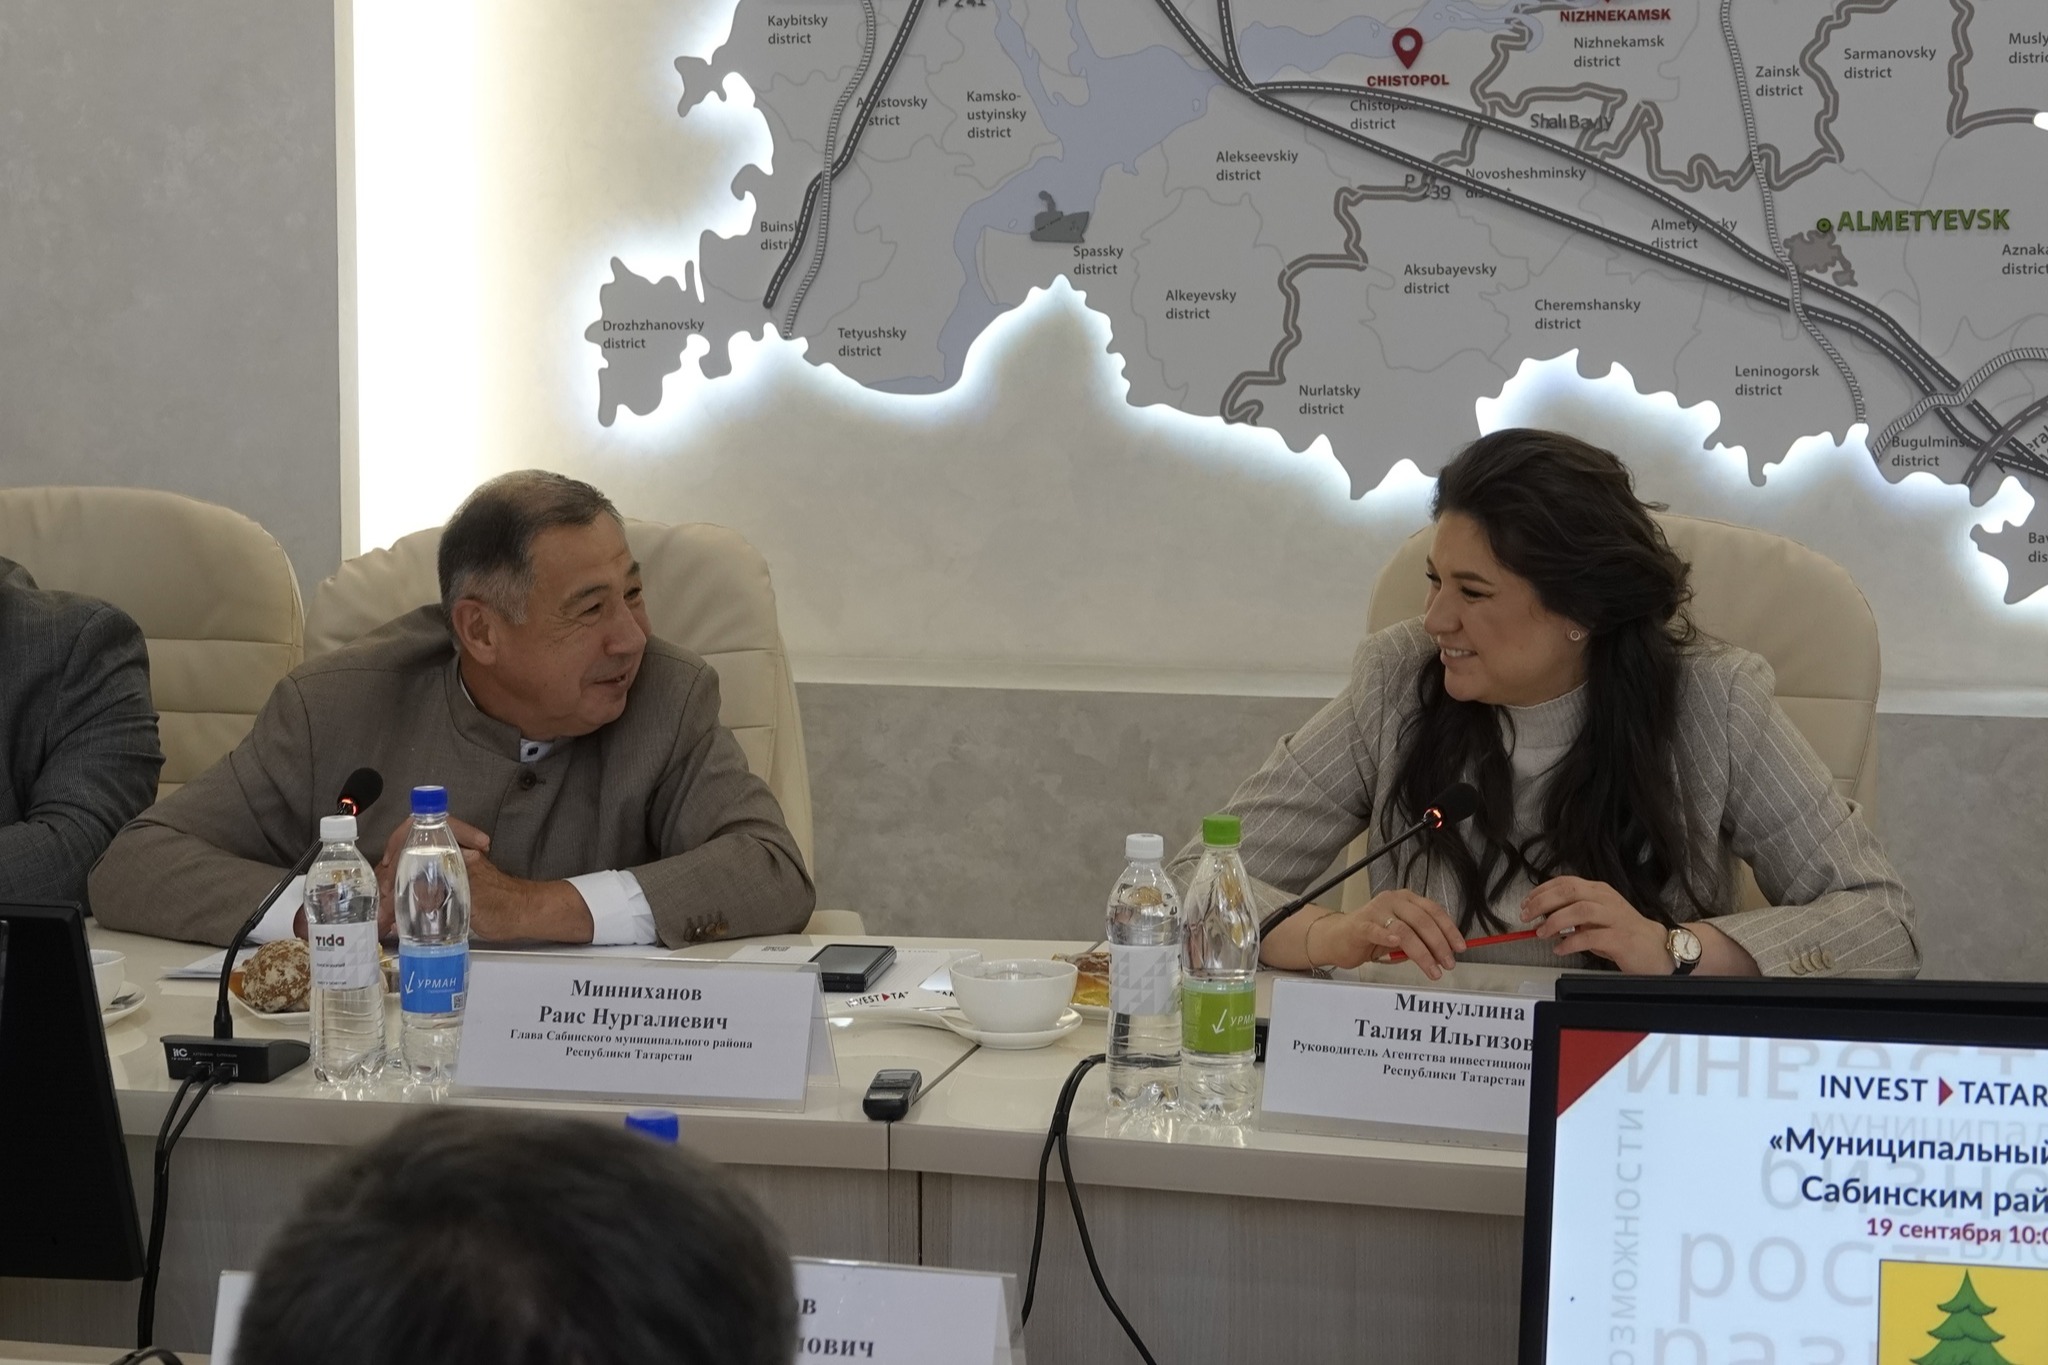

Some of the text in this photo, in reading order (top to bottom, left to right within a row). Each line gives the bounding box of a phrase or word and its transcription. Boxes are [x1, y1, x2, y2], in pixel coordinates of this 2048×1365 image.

[767, 14, 828, 28] Kaybitsky
[1560, 8, 1671, 22] NIZHNEKAMSK
[767, 31, 812, 45] district
[1574, 36, 1665, 49] Nizhnekamsk
[1844, 46, 1937, 61] Sarmanovsky
[1574, 56, 1621, 67] district
[1755, 65, 1800, 78] Zainsk
[1844, 66, 1892, 79] district
[1366, 74, 1449, 88] CHISTOPOL
[966, 90, 1022, 103] Kamsko-
[1755, 84, 1803, 97] district
[868, 114, 900, 126] strict
[966, 108, 1027, 123] ustyinsky
[1350, 117, 1396, 130] district
[966, 126, 1011, 139] district
[1216, 151, 1299, 164] Alekseevskiy
[1216, 169, 1261, 181] district
[1465, 166, 1587, 181] Novosheshminsky
[1837, 209, 2010, 232] ALMETYEVSK
[1651, 237, 1698, 250] district
[1073, 246, 1123, 260] Spassky
[1073, 263, 1117, 276] district
[1404, 263, 1496, 277] Aksubayevsky
[1404, 282, 1450, 295] district
[1165, 289, 1236, 304] Alkeyevsky
[1534, 298, 1640, 313] Cheremshansky
[1165, 308, 1210, 320] district
[602, 318, 704, 334] Drozhzhanovsky
[1534, 318, 1581, 330] district
[838, 327, 906, 342] Tetyushsky
[603, 337, 646, 350] district
[838, 345, 881, 357] district
[1735, 365, 1819, 380] Leninogorsk
[1299, 384, 1361, 399] Nurlatsky
[1735, 384, 1782, 397] district
[1299, 403, 1344, 415] district
[1892, 455, 1939, 467] district
[417, 977, 457, 989] УРМАН
[570, 979, 702, 1001] Минниханов
[1394, 992, 1526, 1021] Минуллина
[539, 1005, 728, 1031] Раис Нургалиевич
[1354, 1018, 1422, 1042] Талия
[510, 1029, 753, 1050] Глава Сабинского муниципального района
[565, 1046, 693, 1063] Республики Татарстан
[1293, 1039, 1531, 1071] Руководитель Агентства инвестицион
[1383, 1063, 1526, 1088] Республики Татарстан
[1820, 1074, 2048, 1107] INVEST TATAR
[1801, 1175, 2048, 1217] Сабинским рай
[1867, 1217, 1893, 1237] 19
[1899, 1223, 2001, 1246] сентября
